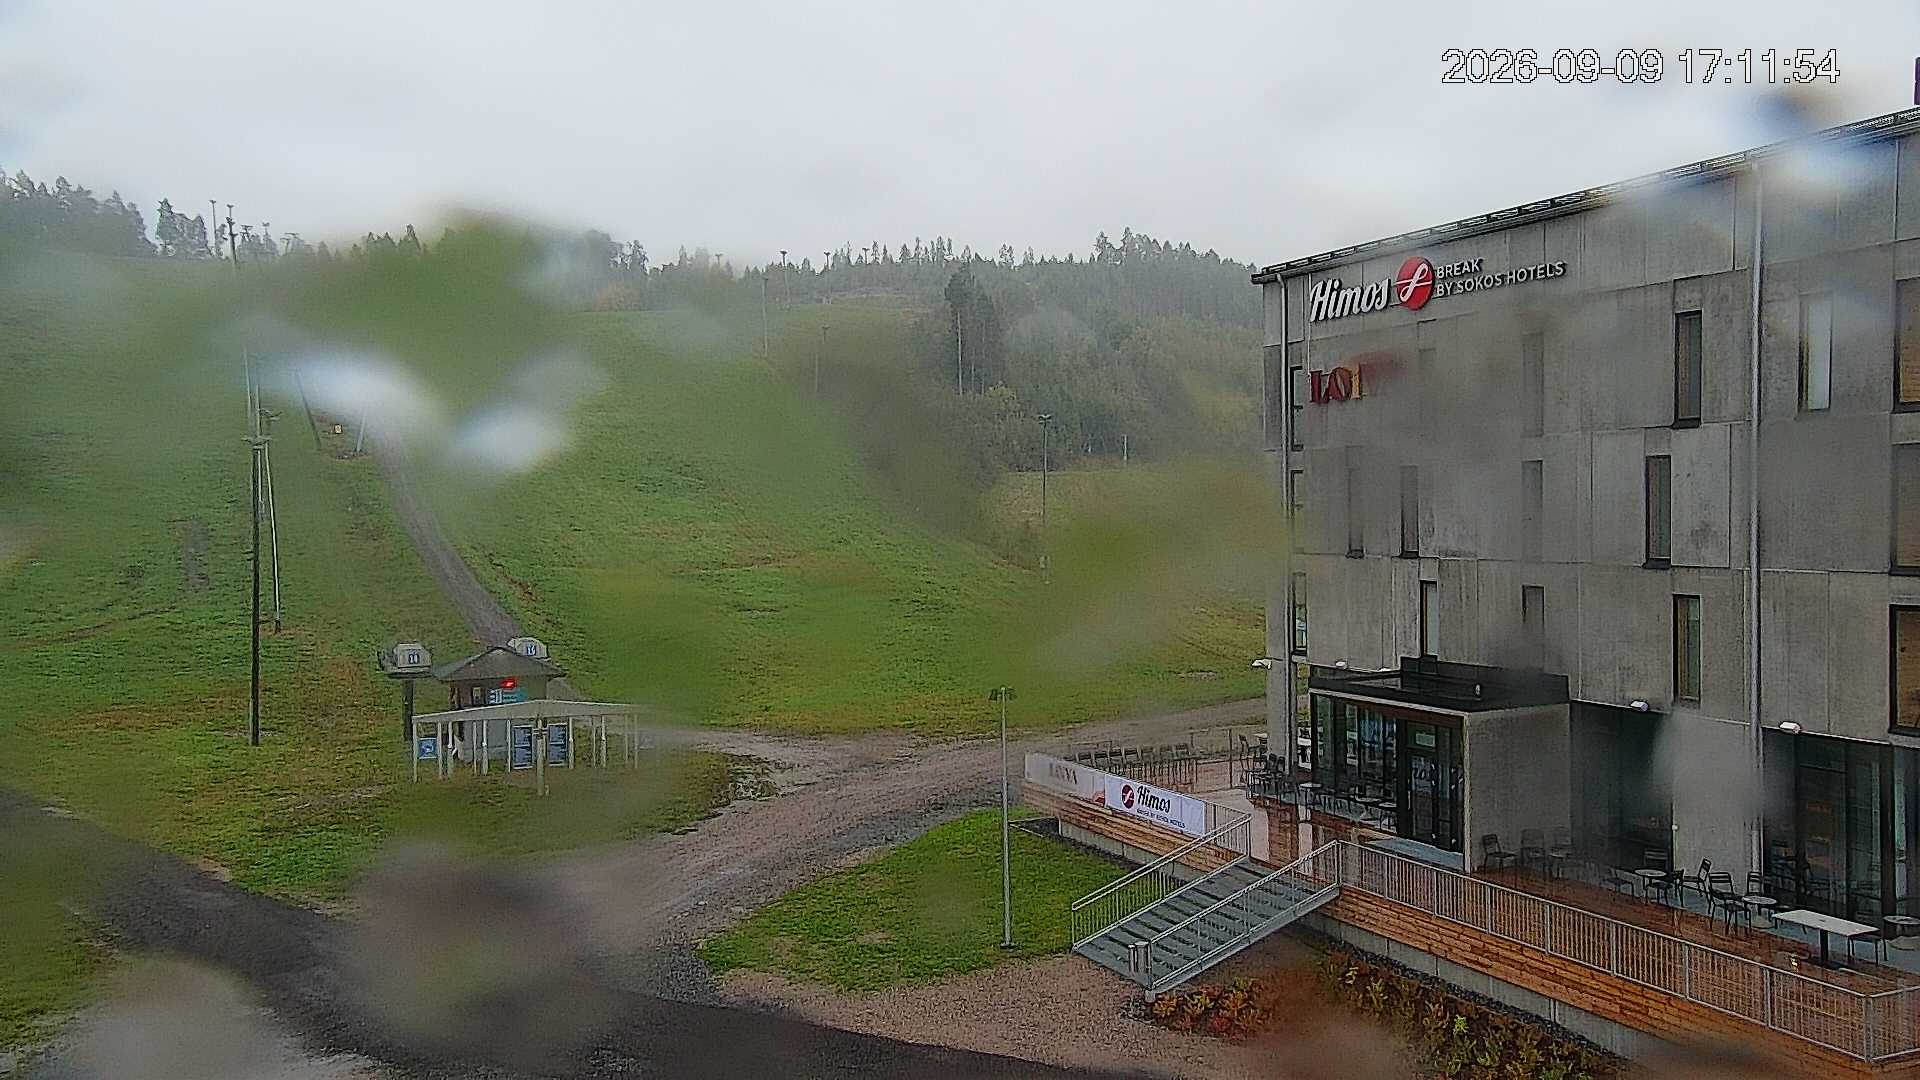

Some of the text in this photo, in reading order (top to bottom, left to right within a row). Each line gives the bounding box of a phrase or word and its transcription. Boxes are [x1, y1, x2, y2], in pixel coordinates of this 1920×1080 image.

[1437, 258, 1482, 279] BREAK
[1437, 261, 1565, 297] BY SOKOS HOTELS
[1310, 278, 1390, 322] Himos
[1137, 785, 1171, 813] Himos
